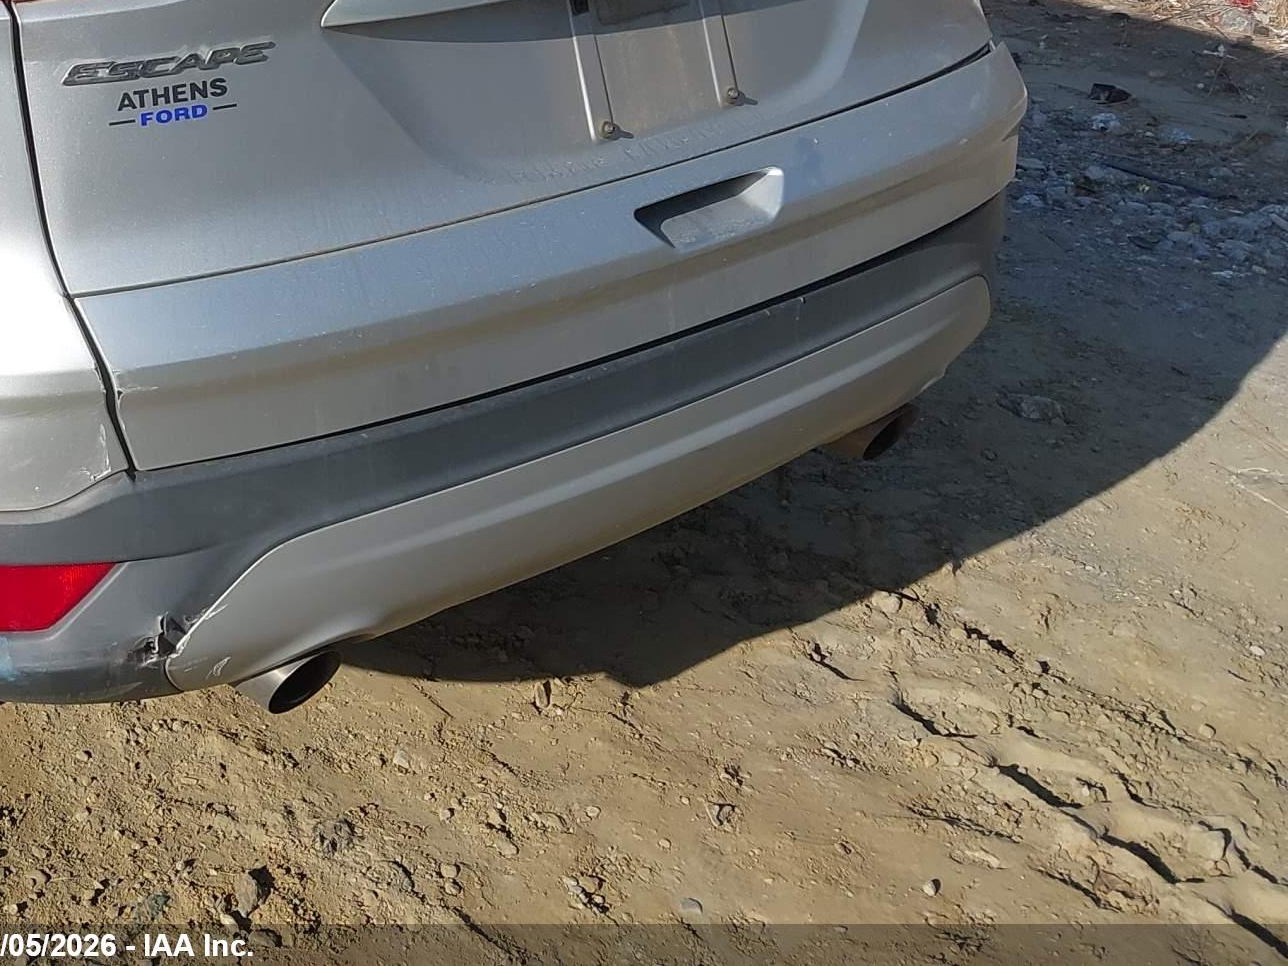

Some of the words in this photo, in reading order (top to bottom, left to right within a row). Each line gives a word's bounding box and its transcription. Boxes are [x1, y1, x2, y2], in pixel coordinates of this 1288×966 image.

[61, 41, 276, 87] ESCAPE
[117, 77, 228, 112] ATHENS
[140, 104, 208, 127] FORD
